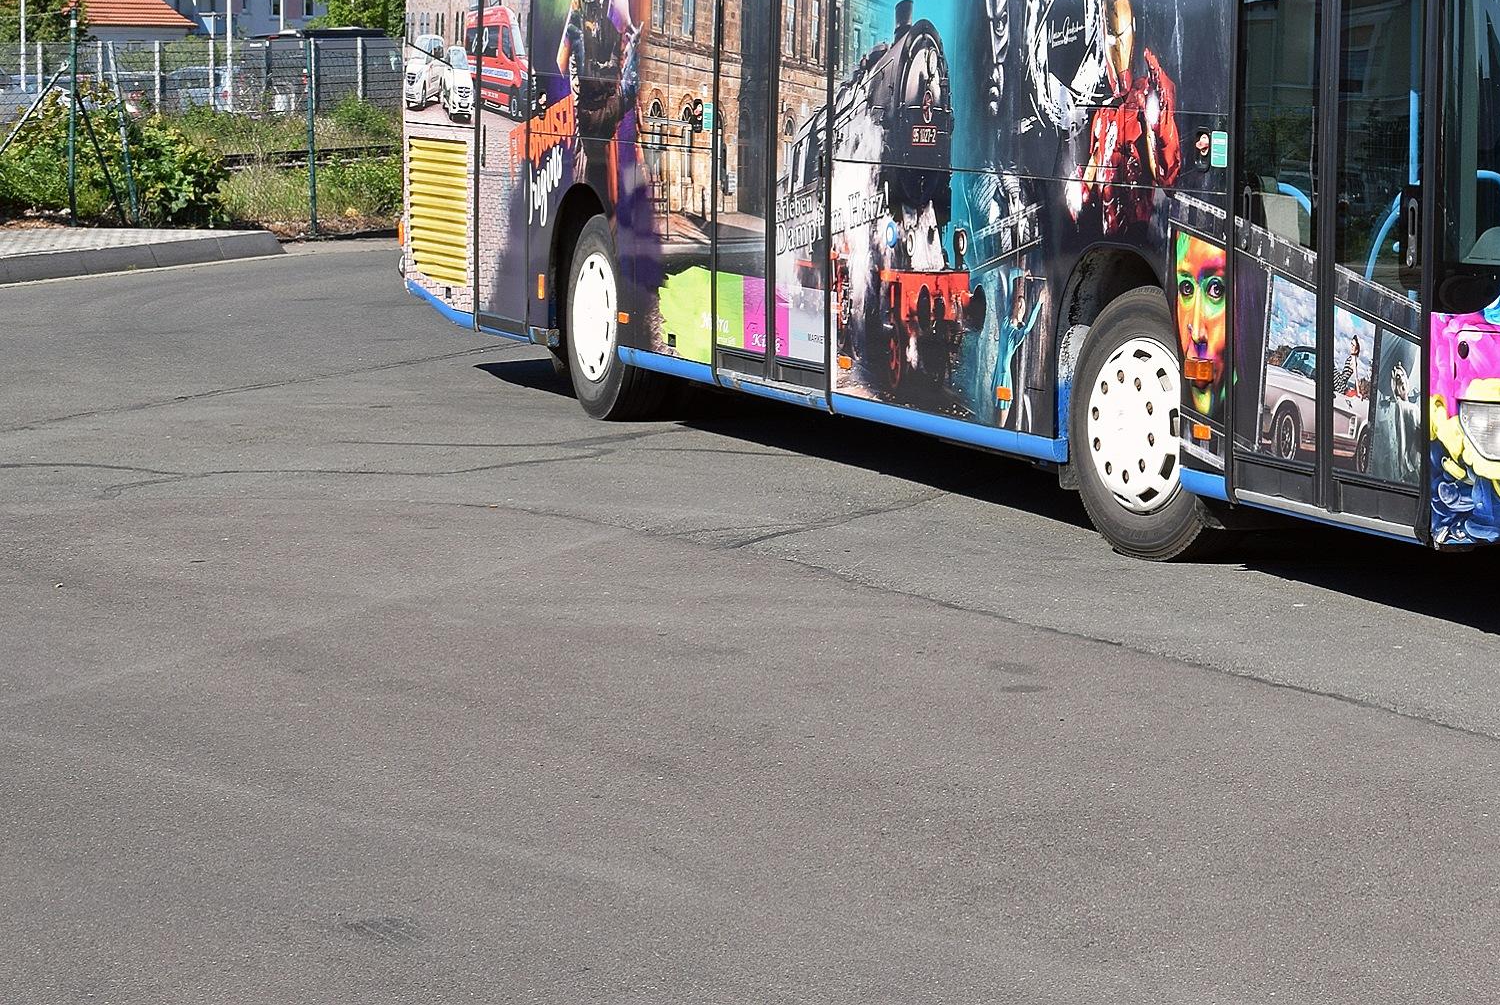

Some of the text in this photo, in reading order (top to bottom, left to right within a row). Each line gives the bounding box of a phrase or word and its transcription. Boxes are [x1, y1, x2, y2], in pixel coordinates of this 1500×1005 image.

[775, 195, 813, 224] Erleben
[775, 202, 824, 256] Dampf
[848, 180, 891, 230] Harz!
